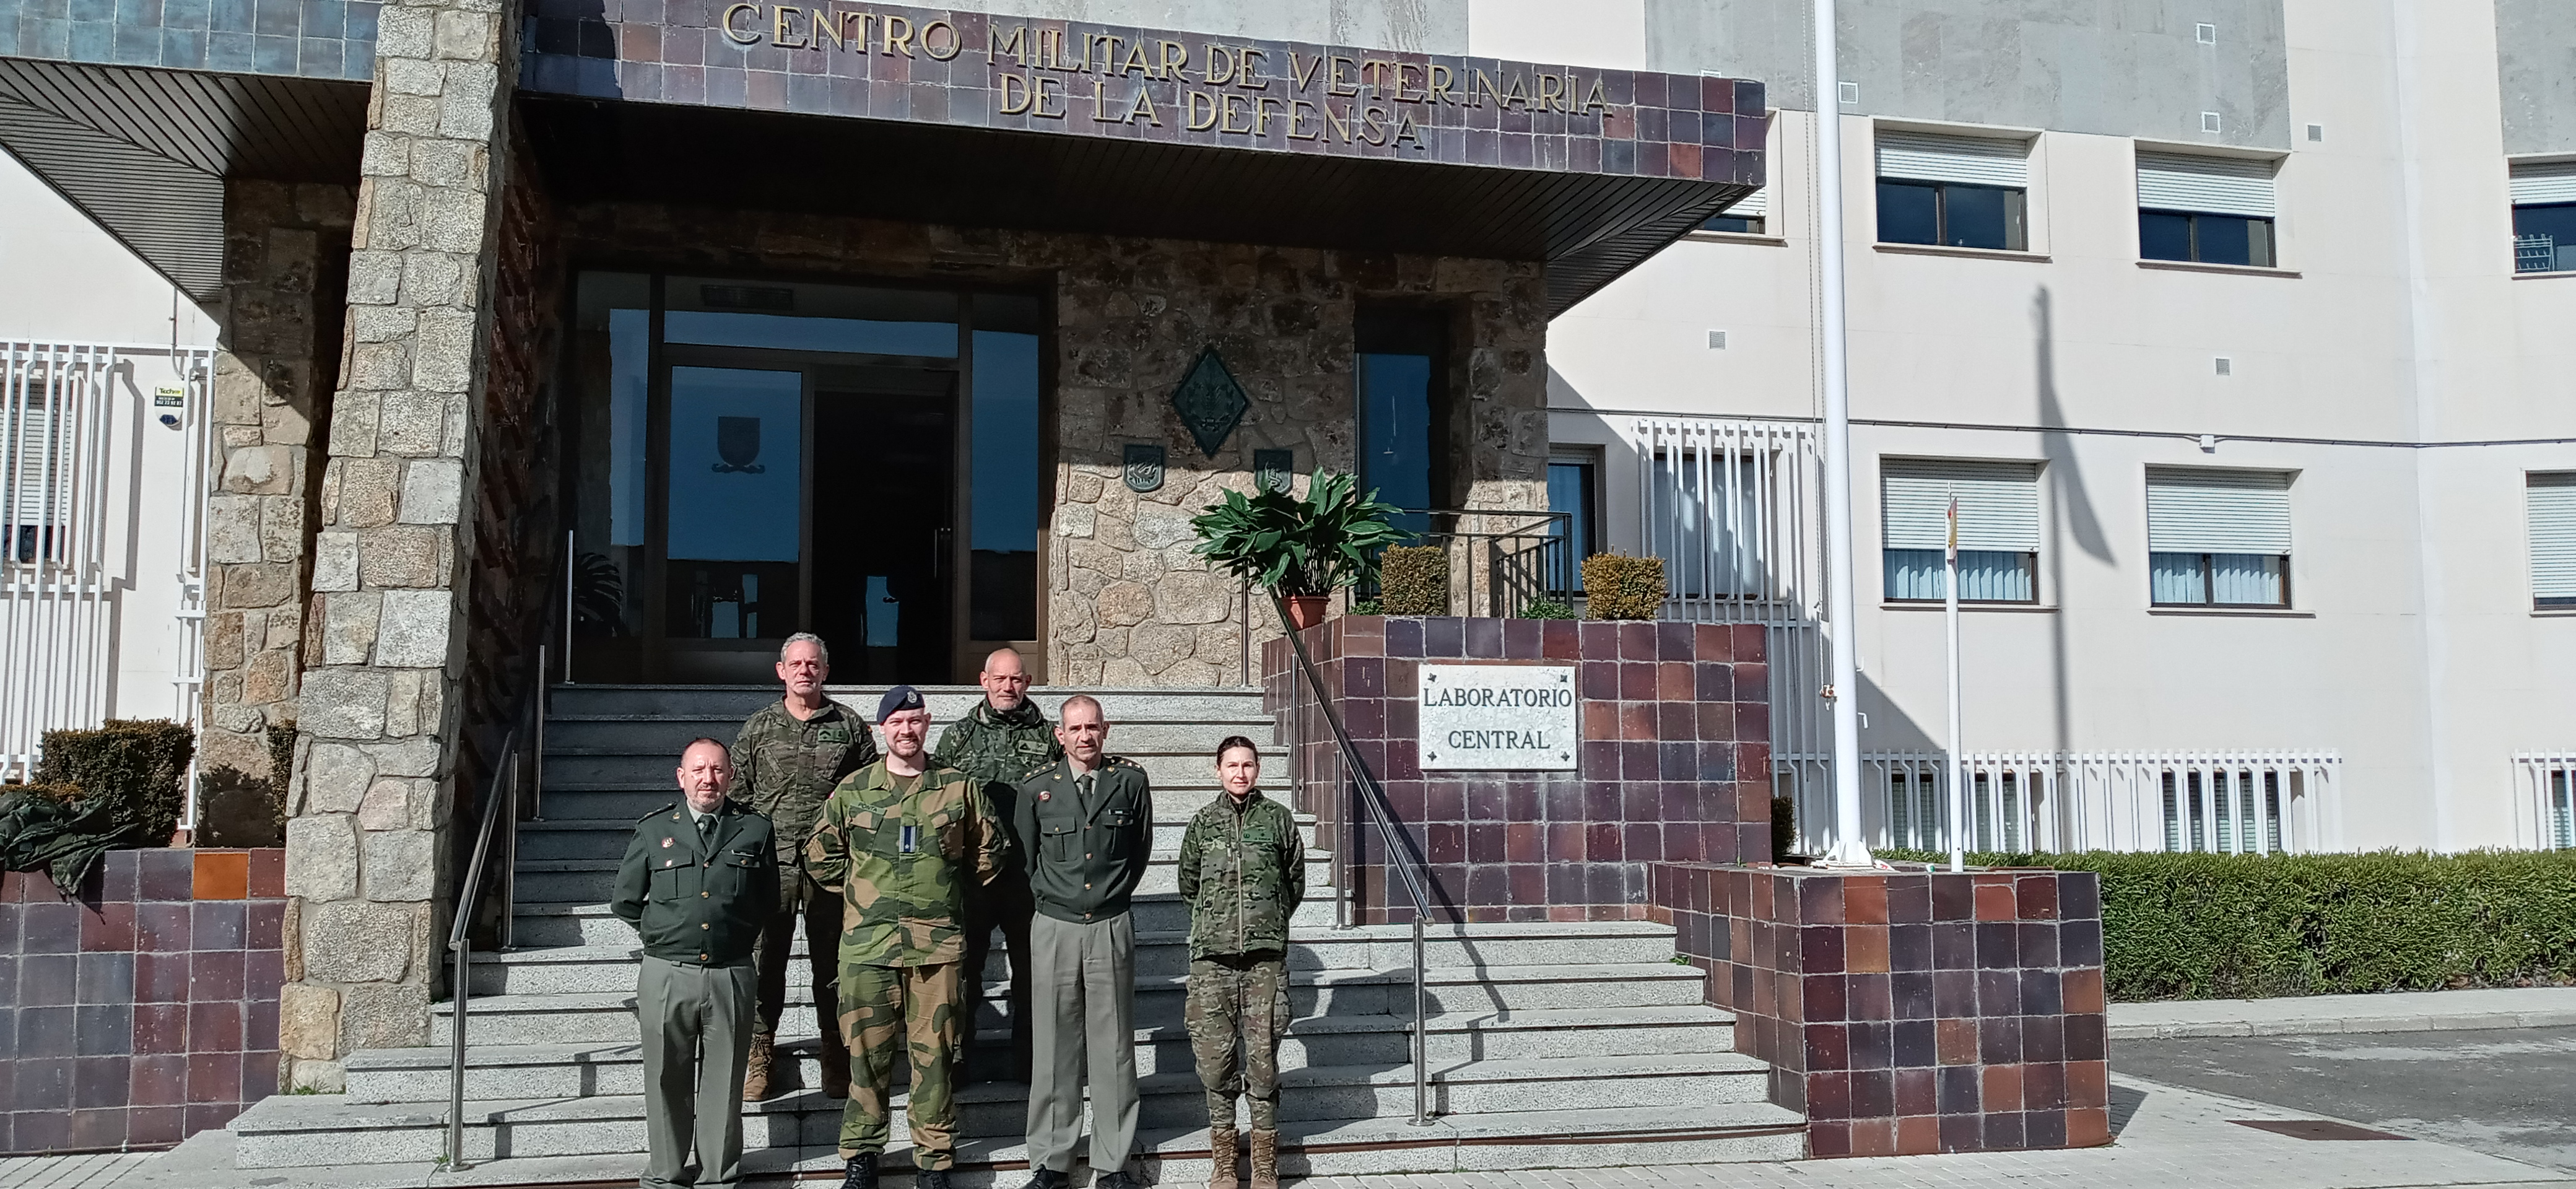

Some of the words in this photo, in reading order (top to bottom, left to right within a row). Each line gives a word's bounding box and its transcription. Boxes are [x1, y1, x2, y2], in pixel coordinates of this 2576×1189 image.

[722, 2, 961, 61] CENTRO
[987, 24, 1190, 84] MILITAR
[1204, 44, 1269, 90] DE
[1288, 52, 1614, 118] VETERINARIA
[999, 73, 1066, 120] DE
[1092, 81, 1163, 126] LA
[1186, 90, 1425, 150] DEFENSA
[1424, 688, 1572, 707] LABORATORIO
[1448, 730, 1551, 749] CENTRAL
